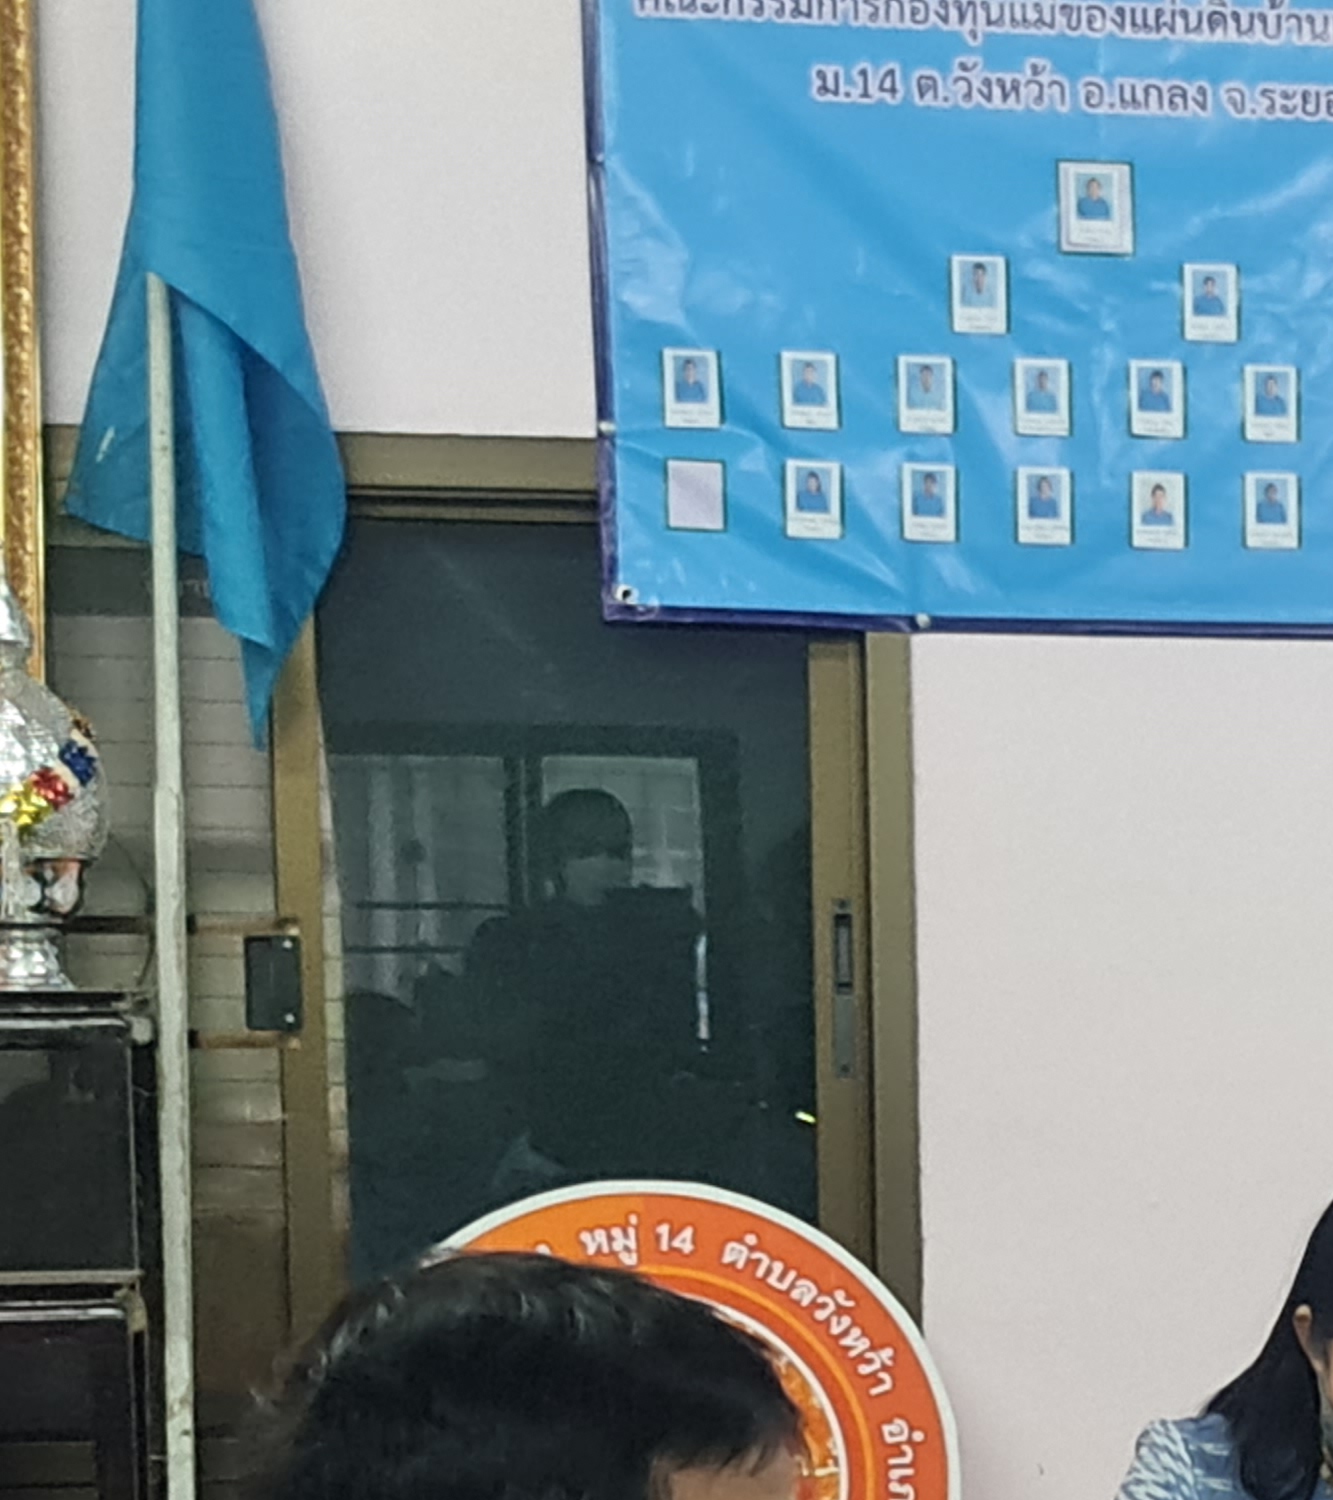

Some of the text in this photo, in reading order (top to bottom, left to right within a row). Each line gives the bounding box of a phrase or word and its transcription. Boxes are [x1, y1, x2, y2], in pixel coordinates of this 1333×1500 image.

[815, 66, 899, 100] ม.14
[916, 61, 1066, 107] ต.วังหว้า
[1084, 79, 1208, 113] อ.แกลง
[579, 1213, 639, 1267] หมู่
[655, 1222, 695, 1255] 14
[720, 1233, 896, 1397] ตำบลวังหว้า
